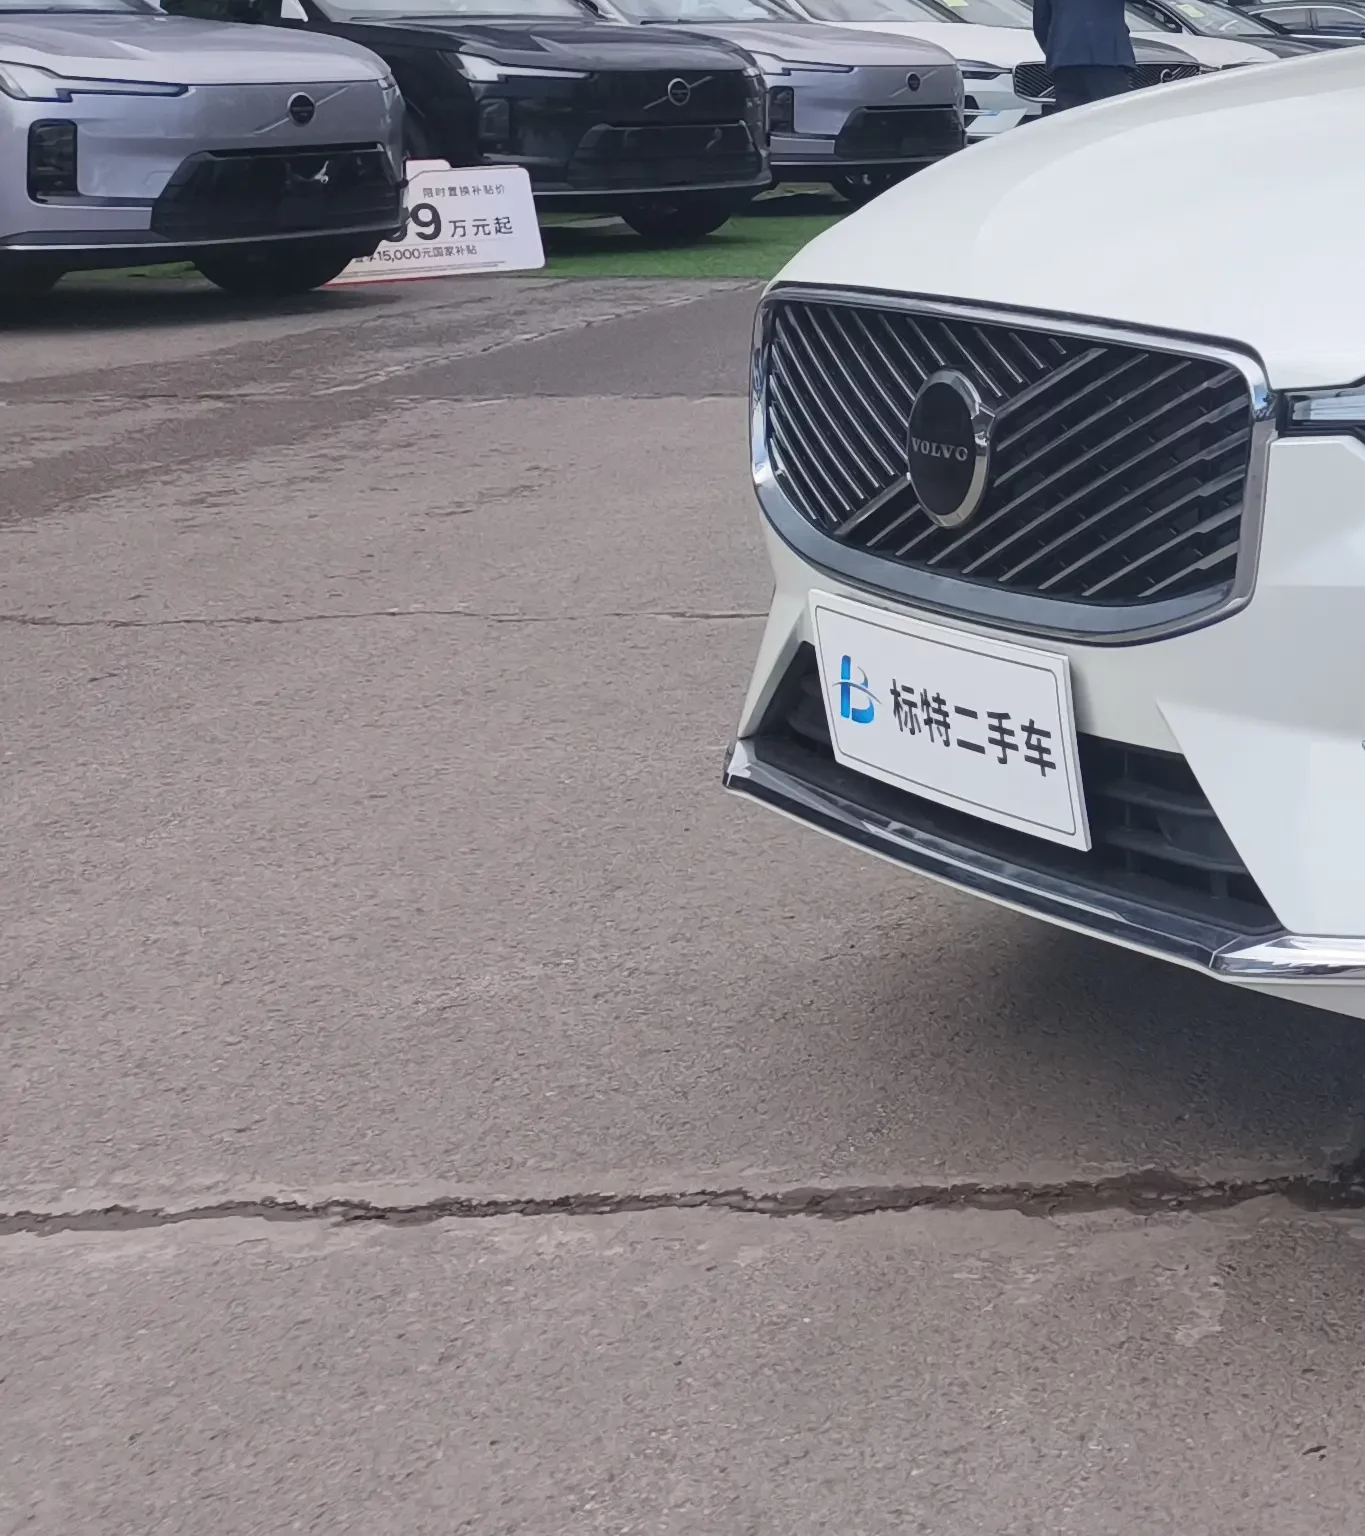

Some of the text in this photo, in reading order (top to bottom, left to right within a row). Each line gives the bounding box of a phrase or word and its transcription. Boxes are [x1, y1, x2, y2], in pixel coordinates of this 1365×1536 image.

[422, 184, 505, 199] 限时置换补贴价
[911, 437, 968, 462] VOLVO
[889, 678, 1056, 777] 标特二手车
